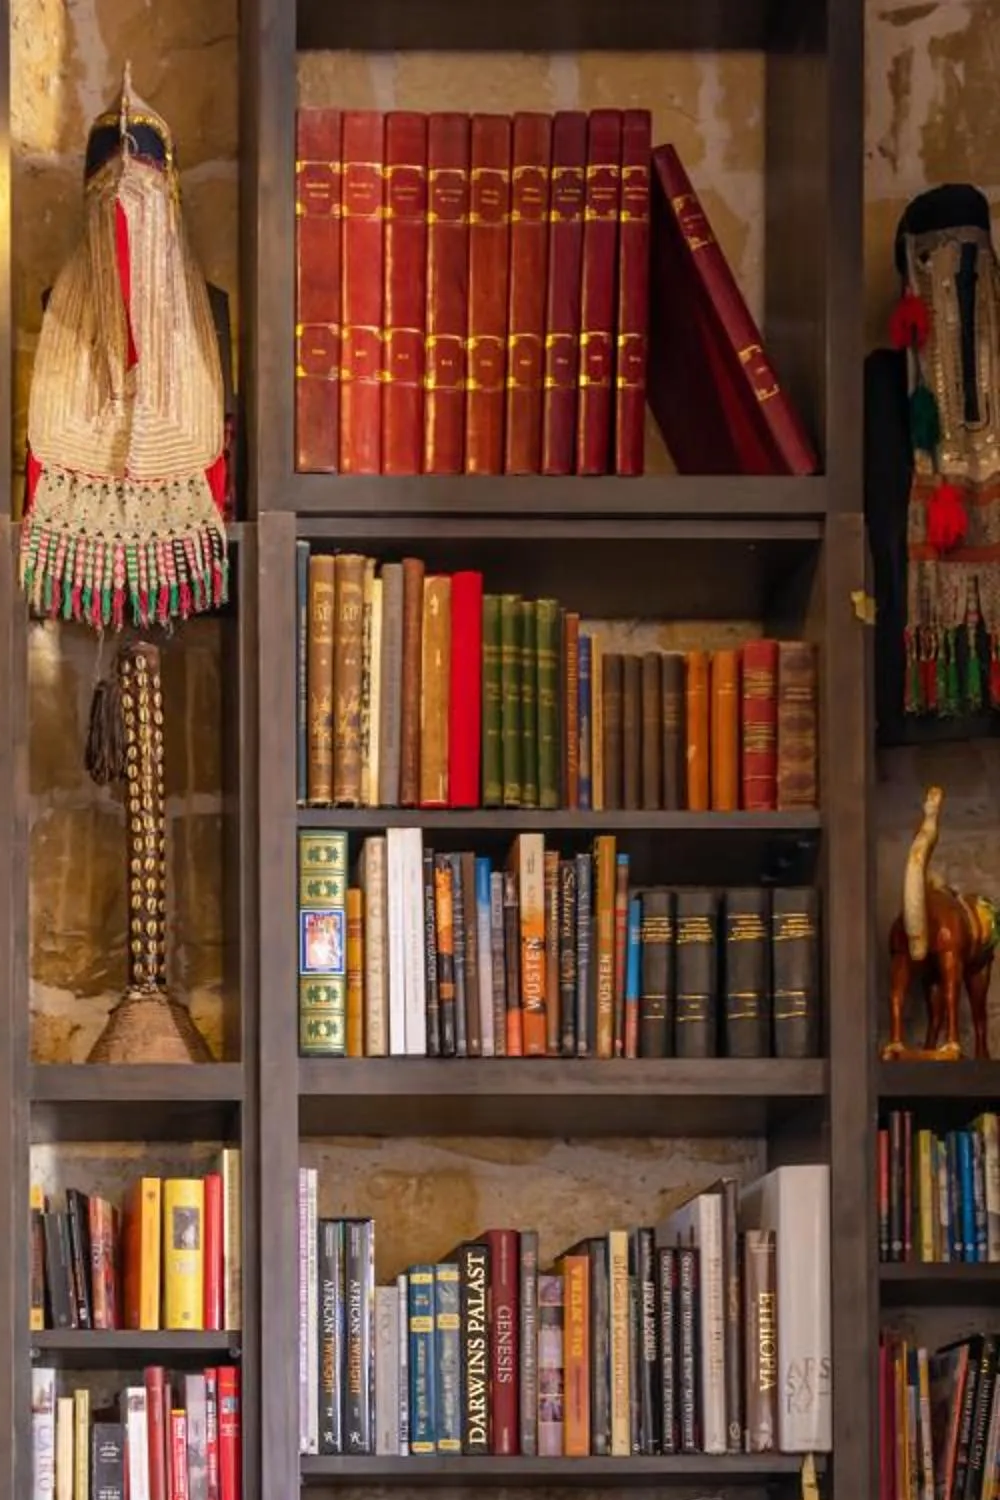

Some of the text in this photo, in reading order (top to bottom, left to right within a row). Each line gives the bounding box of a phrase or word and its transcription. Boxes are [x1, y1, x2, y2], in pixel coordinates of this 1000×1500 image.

[323, 1280, 336, 1393] AFRICAN TWILIGHT
[350, 1280, 362, 1393] AFRICAN TWILIGHT
[467, 1252, 486, 1444] DARWINS PALAST
[496, 1306, 512, 1384] GENESIS
[758, 1292, 774, 1391] ETHIOPIA
[38, 1424, 52, 1492] CAIRO
